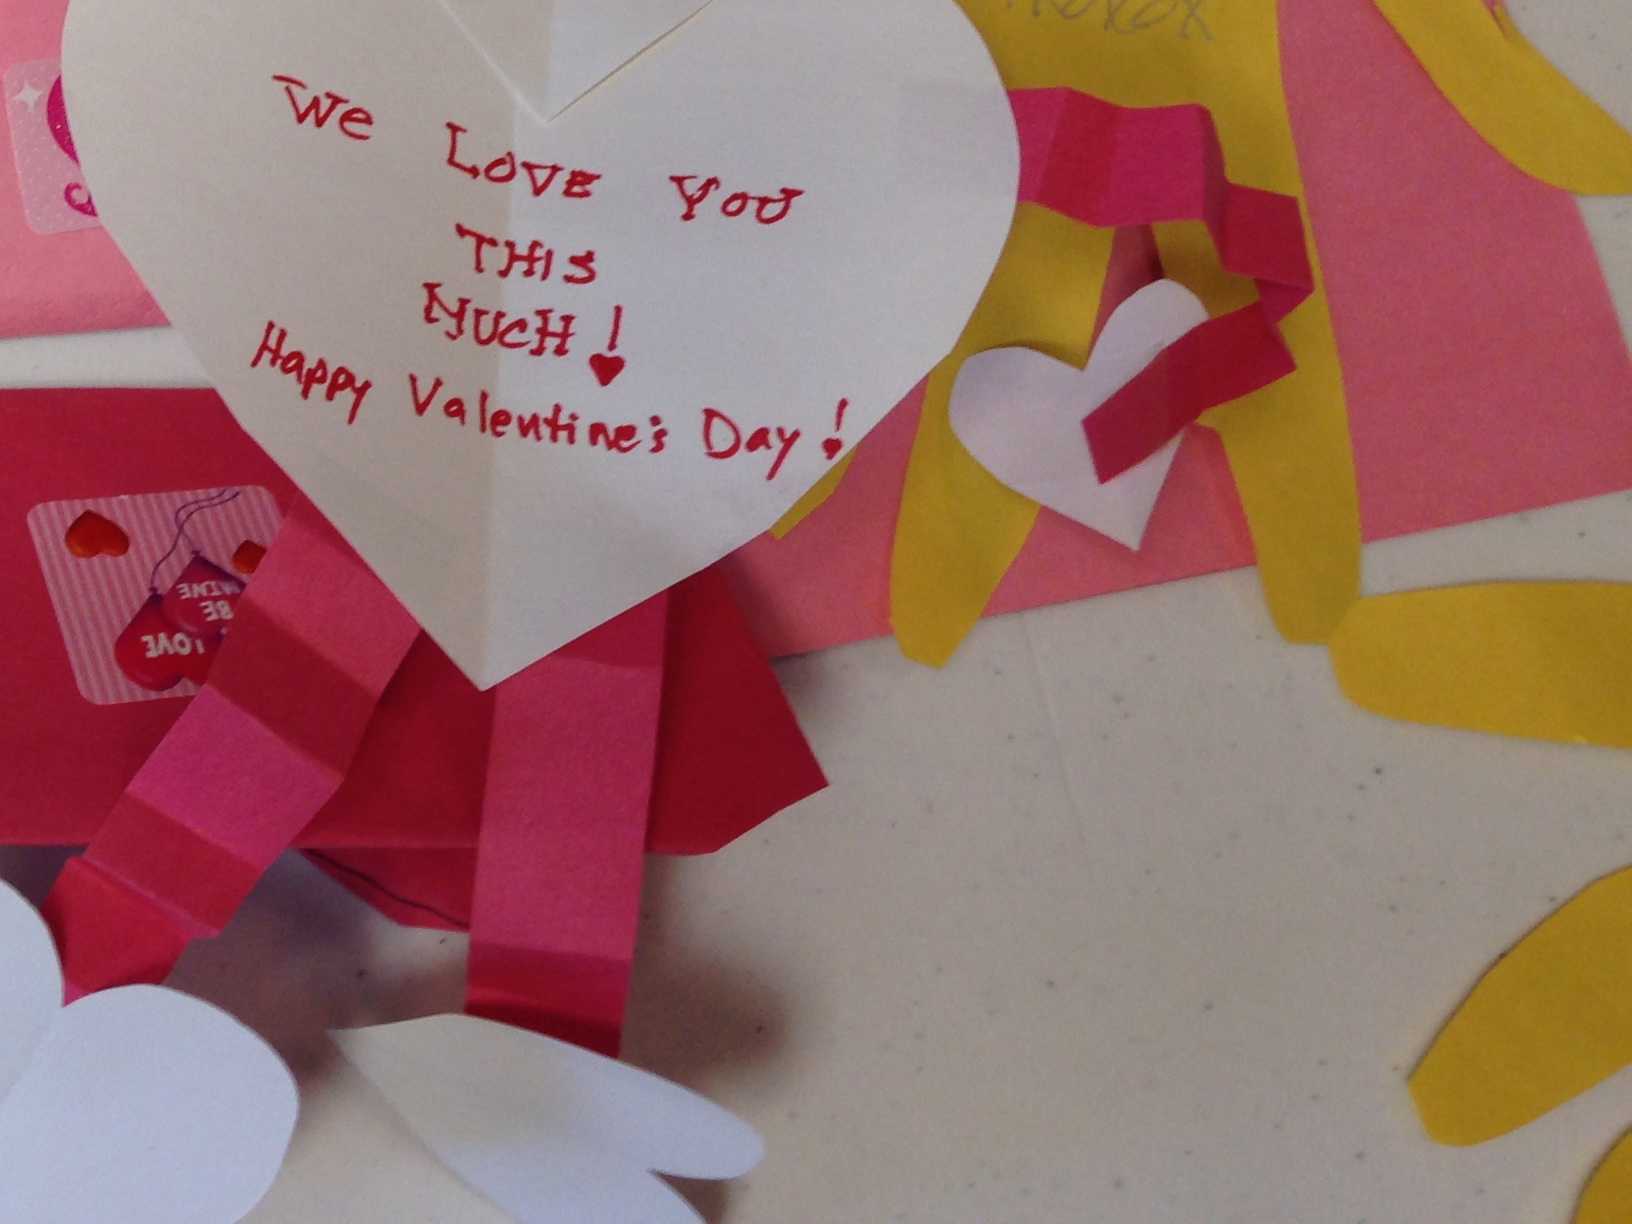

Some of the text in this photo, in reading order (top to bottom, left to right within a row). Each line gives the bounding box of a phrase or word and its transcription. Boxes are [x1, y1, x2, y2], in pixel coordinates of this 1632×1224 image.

[272, 74, 375, 140] We
[444, 121, 602, 199] LOVE
[455, 223, 599, 285] THIS
[250, 320, 372, 425] Happy
[407, 373, 668, 454] Valentine's
